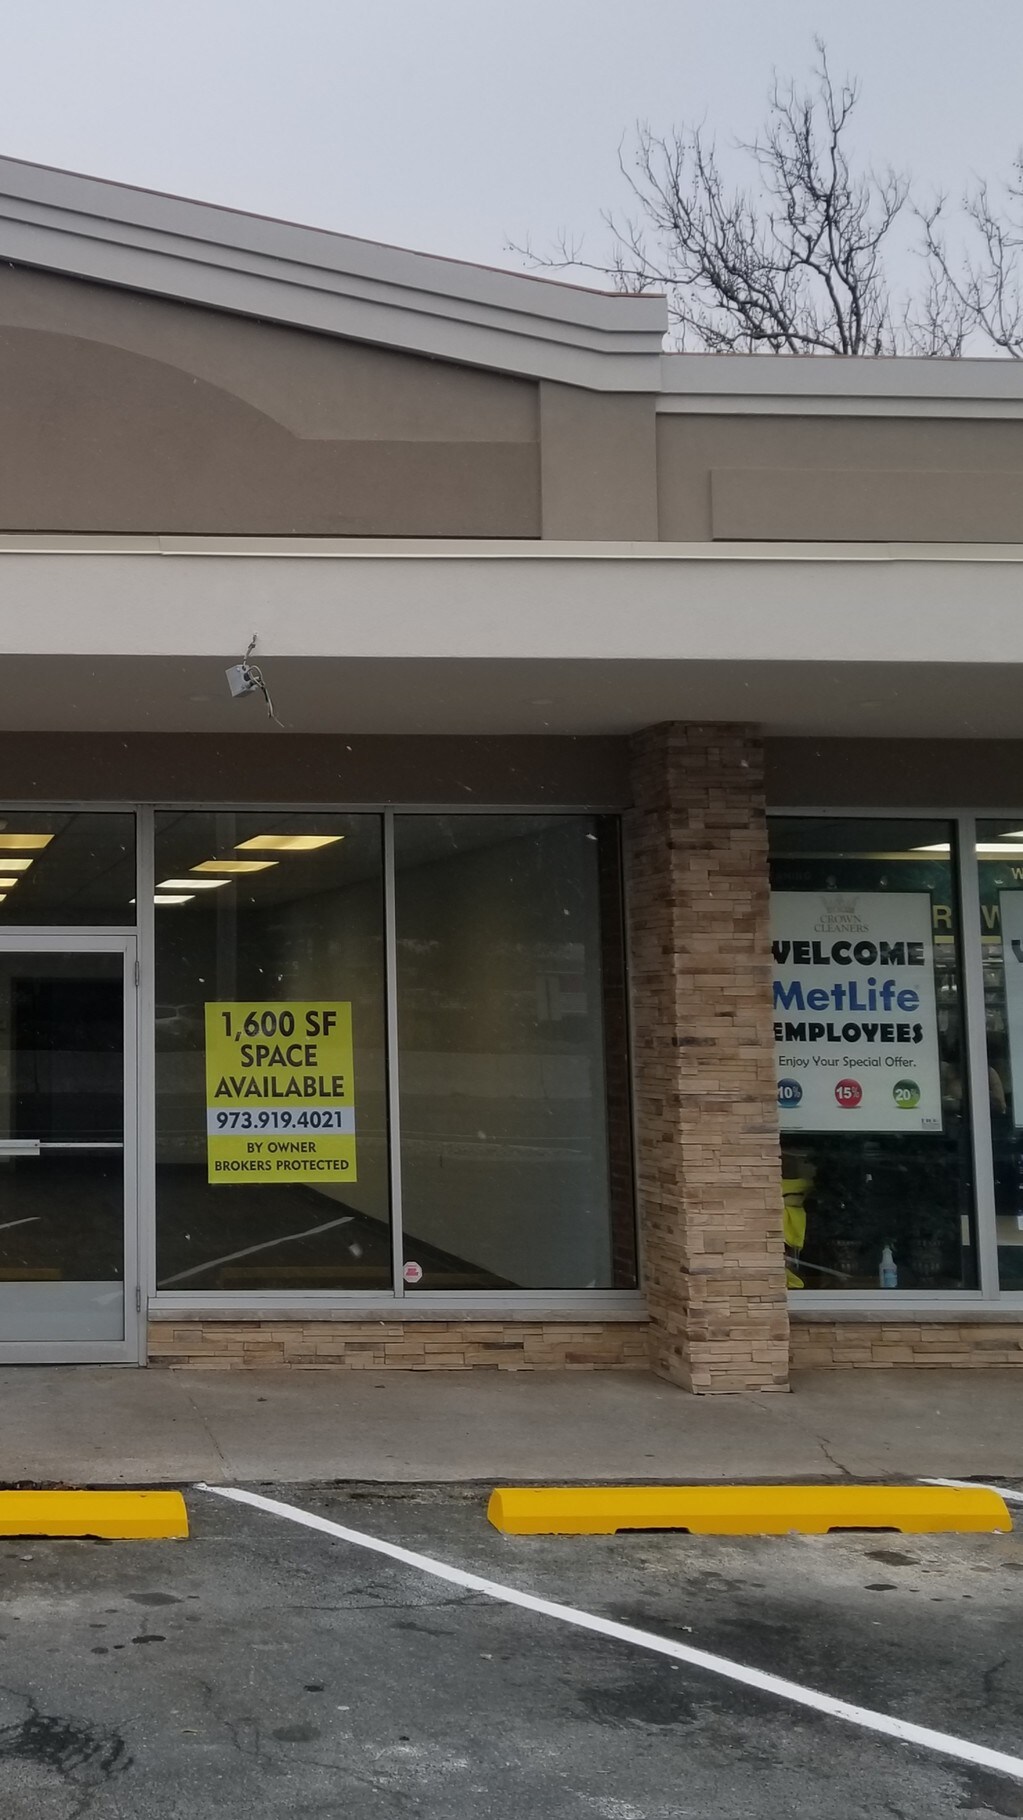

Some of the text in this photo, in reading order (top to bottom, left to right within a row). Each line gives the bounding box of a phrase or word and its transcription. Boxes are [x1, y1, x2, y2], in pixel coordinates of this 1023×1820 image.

[819, 914, 862, 924] CROWN
[813, 924, 869, 933] CLEANERS
[772, 976, 920, 1012] MetLife
[221, 1010, 337, 1042] 1,600 SF
[773, 1022, 924, 1044] EMPLOYEES
[240, 1043, 318, 1068] SPACE
[778, 1055, 917, 1069] Enjoy Your Special Offer.
[214, 1075, 345, 1099] AVAILABLE
[836, 1086, 860, 1099] 15%
[216, 1110, 342, 1130] 973.919.4021
[247, 1141, 317, 1153] BY OWNER
[214, 1159, 349, 1172] BROKERS PROTECTED
